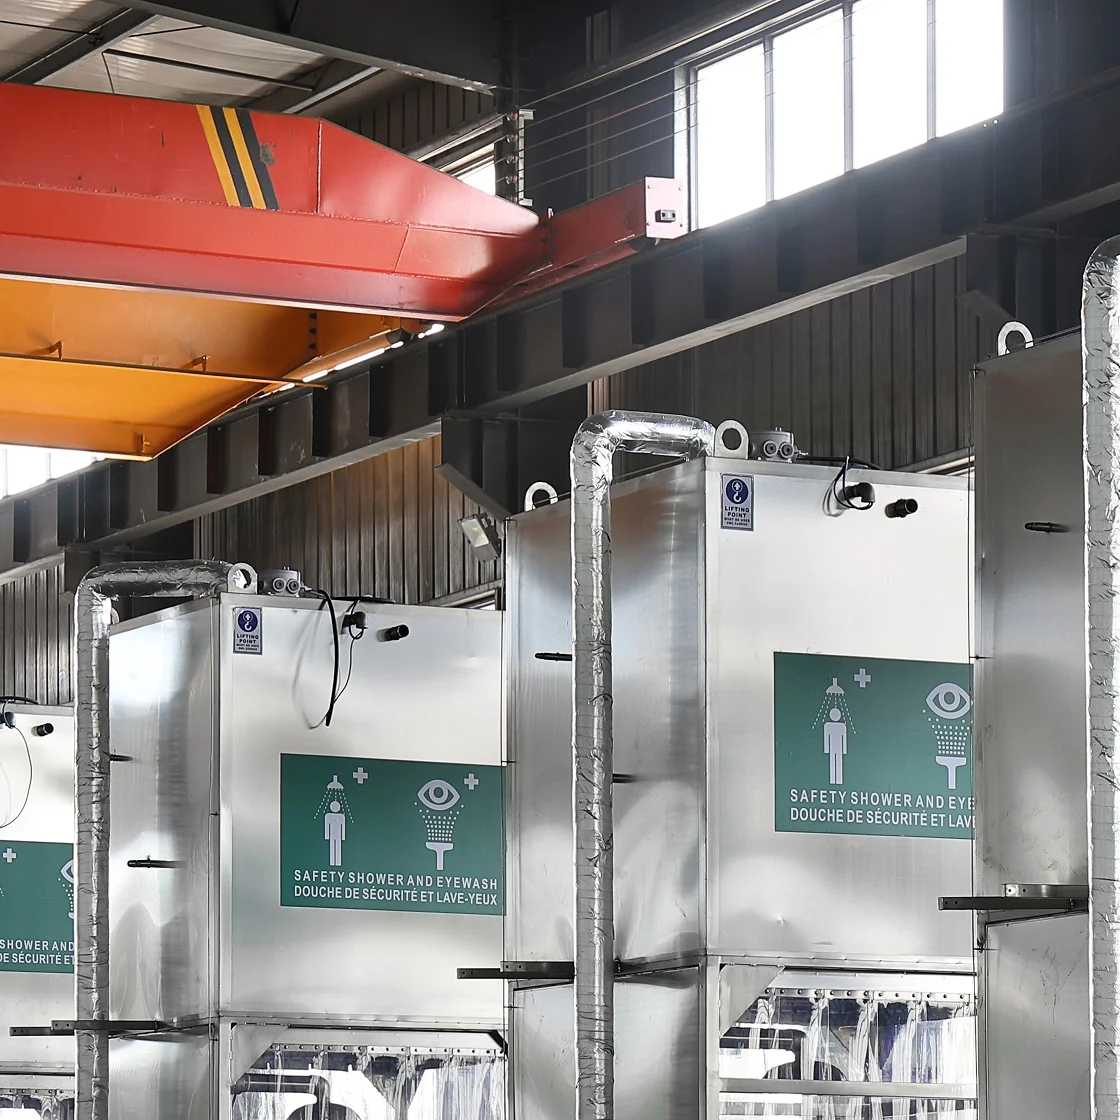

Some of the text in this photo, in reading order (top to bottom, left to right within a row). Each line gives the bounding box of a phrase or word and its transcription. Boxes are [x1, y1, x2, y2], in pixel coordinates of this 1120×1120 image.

[790, 788, 847, 804] SAFETY
[850, 791, 912, 808] SHOWER
[915, 795, 944, 809] AND
[790, 807, 844, 821] DOUCHE
[847, 810, 864, 824] DE
[866, 808, 927, 826] SÉCURITÉ
[931, 814, 945, 827] ET
[293, 869, 498, 890] SAFETY SHOWER AND EYEWASH
[293, 886, 498, 906] DOUCHE DE SÉCURITÉ ET LAVE-YEUX
[0, 940, 74, 952] SHOWER AND
[12, 951, 61, 965] SÉCURITÉ
